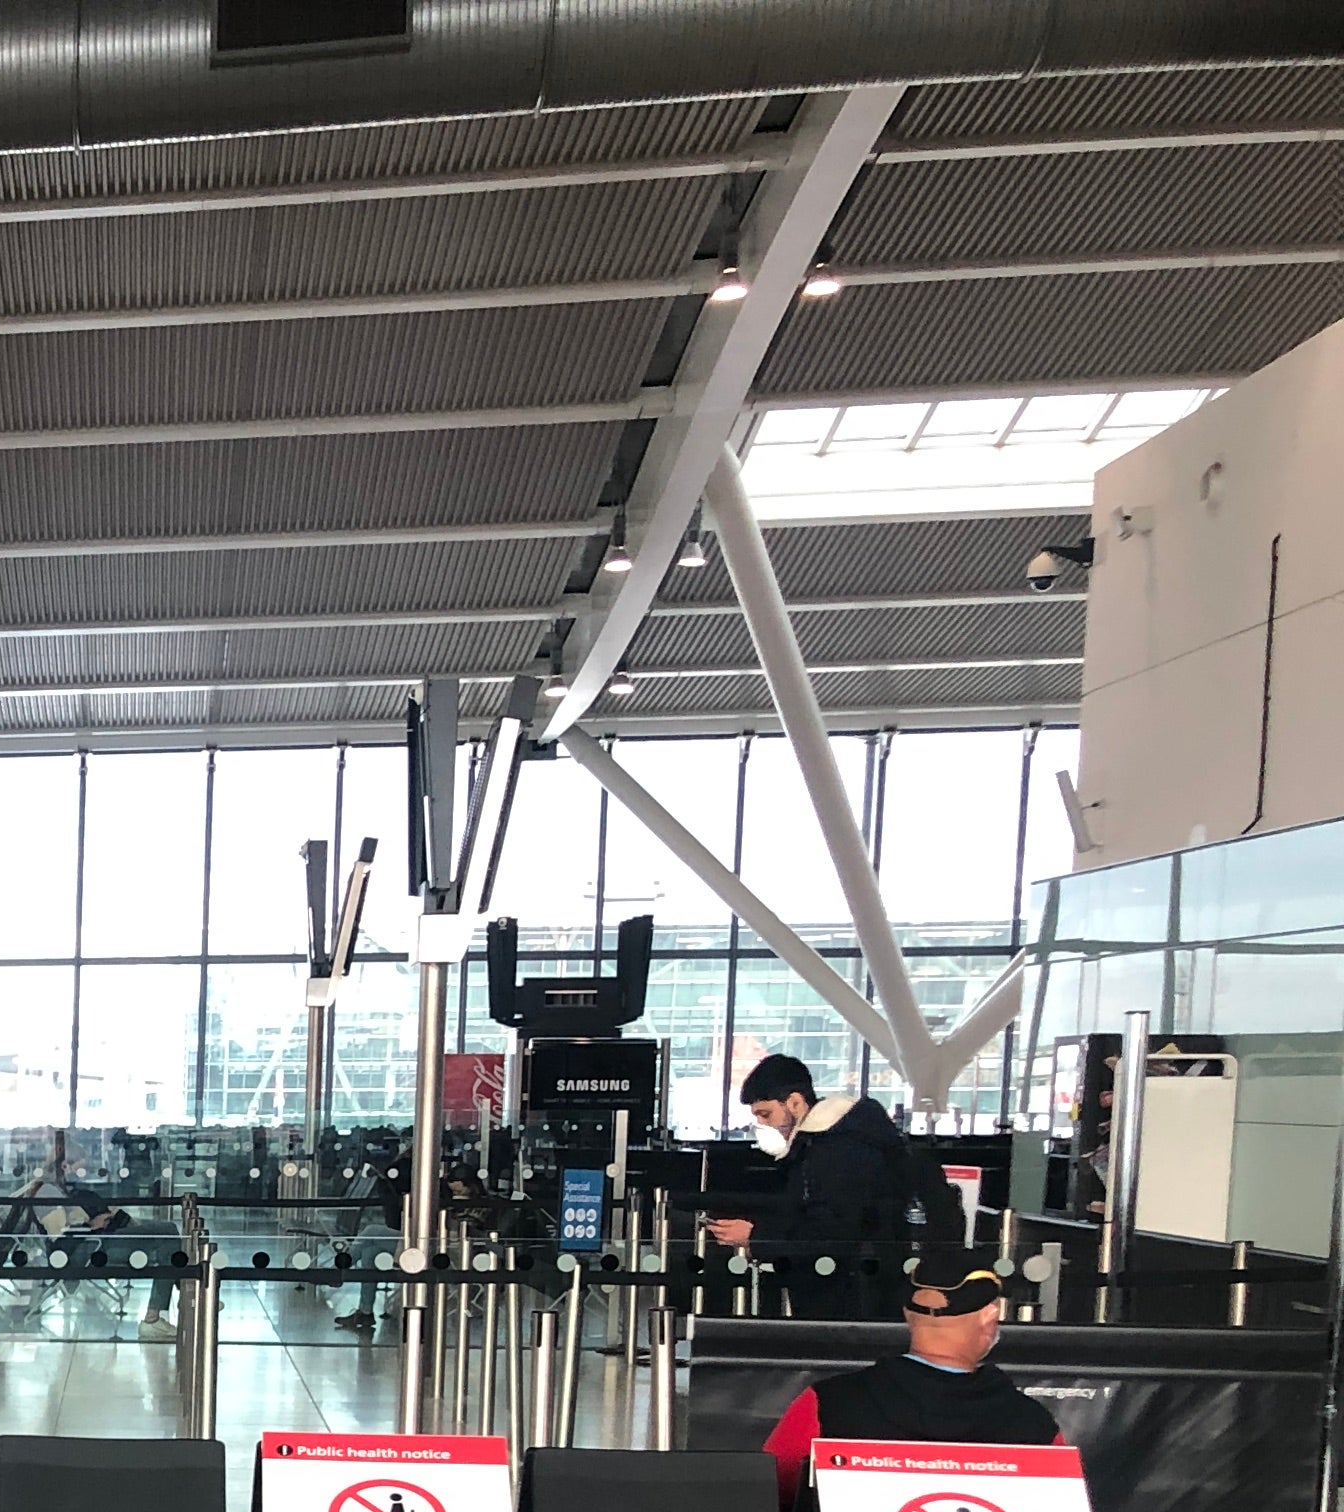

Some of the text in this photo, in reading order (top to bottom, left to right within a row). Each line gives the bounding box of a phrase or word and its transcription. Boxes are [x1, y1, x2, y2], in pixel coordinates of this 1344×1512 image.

[556, 1079, 630, 1092] SAMSUNG
[296, 1445, 451, 1460] Public health notice
[851, 1455, 1018, 1472] Public health notice
